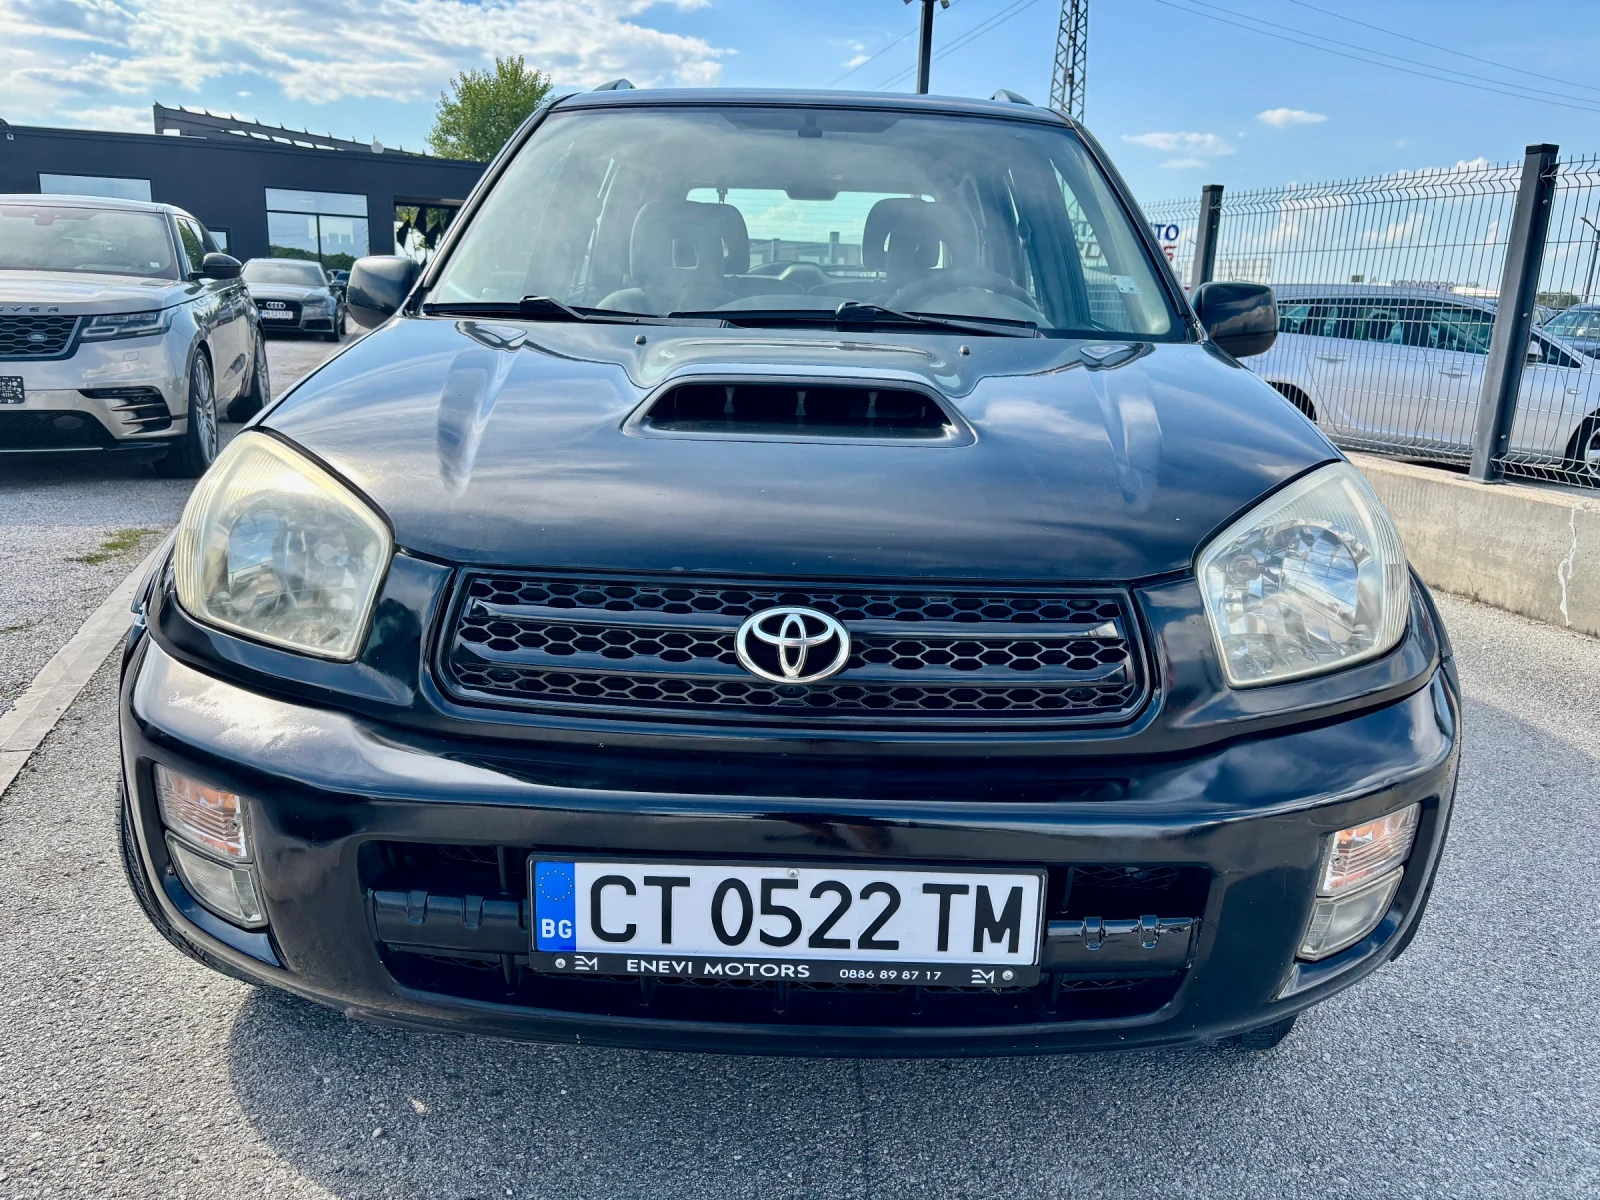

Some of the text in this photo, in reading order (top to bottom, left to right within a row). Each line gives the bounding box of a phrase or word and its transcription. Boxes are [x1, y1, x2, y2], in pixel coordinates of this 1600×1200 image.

[1150, 222, 1180, 241] TO
[590, 875, 1023, 953] CT 0522 TM
[541, 918, 572, 939] BG
[626, 959, 810, 978] ENEVI MOTORS
[839, 968, 942, 981] 0886 89 87 17
